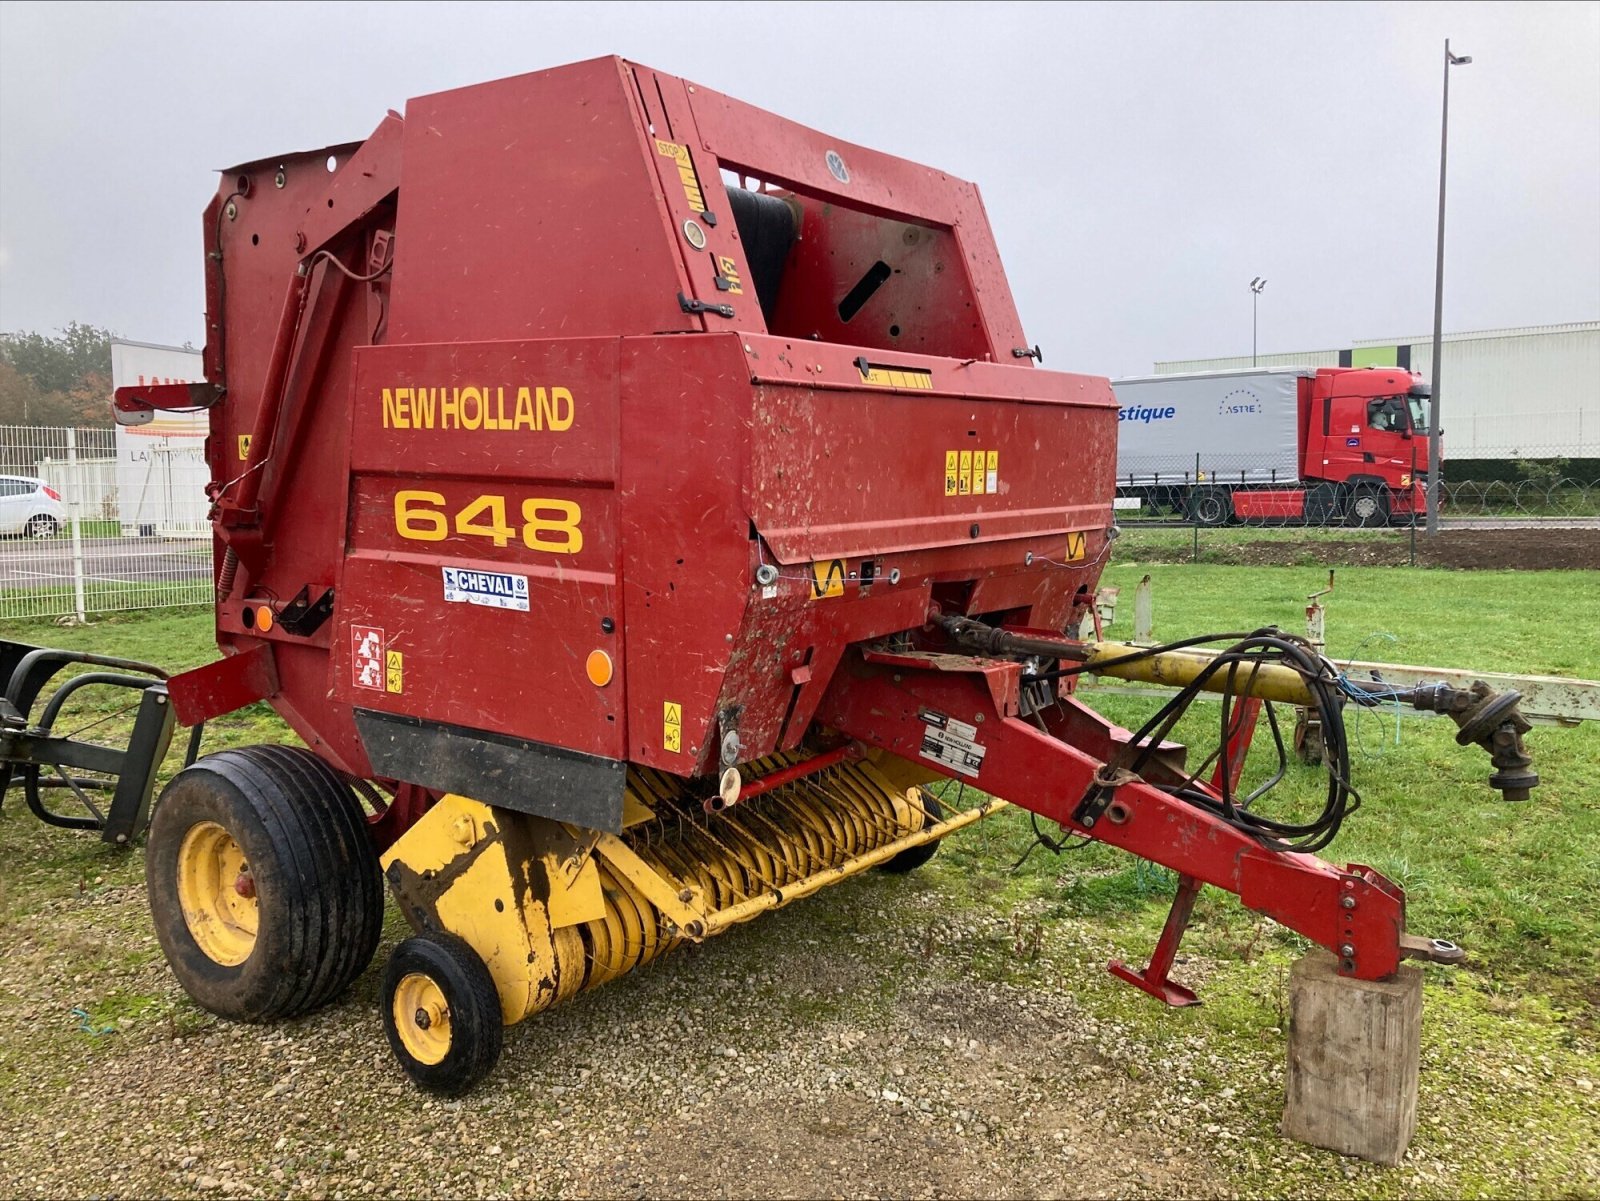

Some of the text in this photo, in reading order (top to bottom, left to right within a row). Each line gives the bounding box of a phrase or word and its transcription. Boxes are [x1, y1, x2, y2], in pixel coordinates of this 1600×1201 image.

[658, 142, 679, 155] STOP
[382, 386, 575, 432] NEW HOLLAND
[1118, 405, 1176, 423] stique
[1225, 405, 1256, 414] ASTRE
[395, 490, 583, 554] 648
[458, 571, 513, 595] CHEVAL
